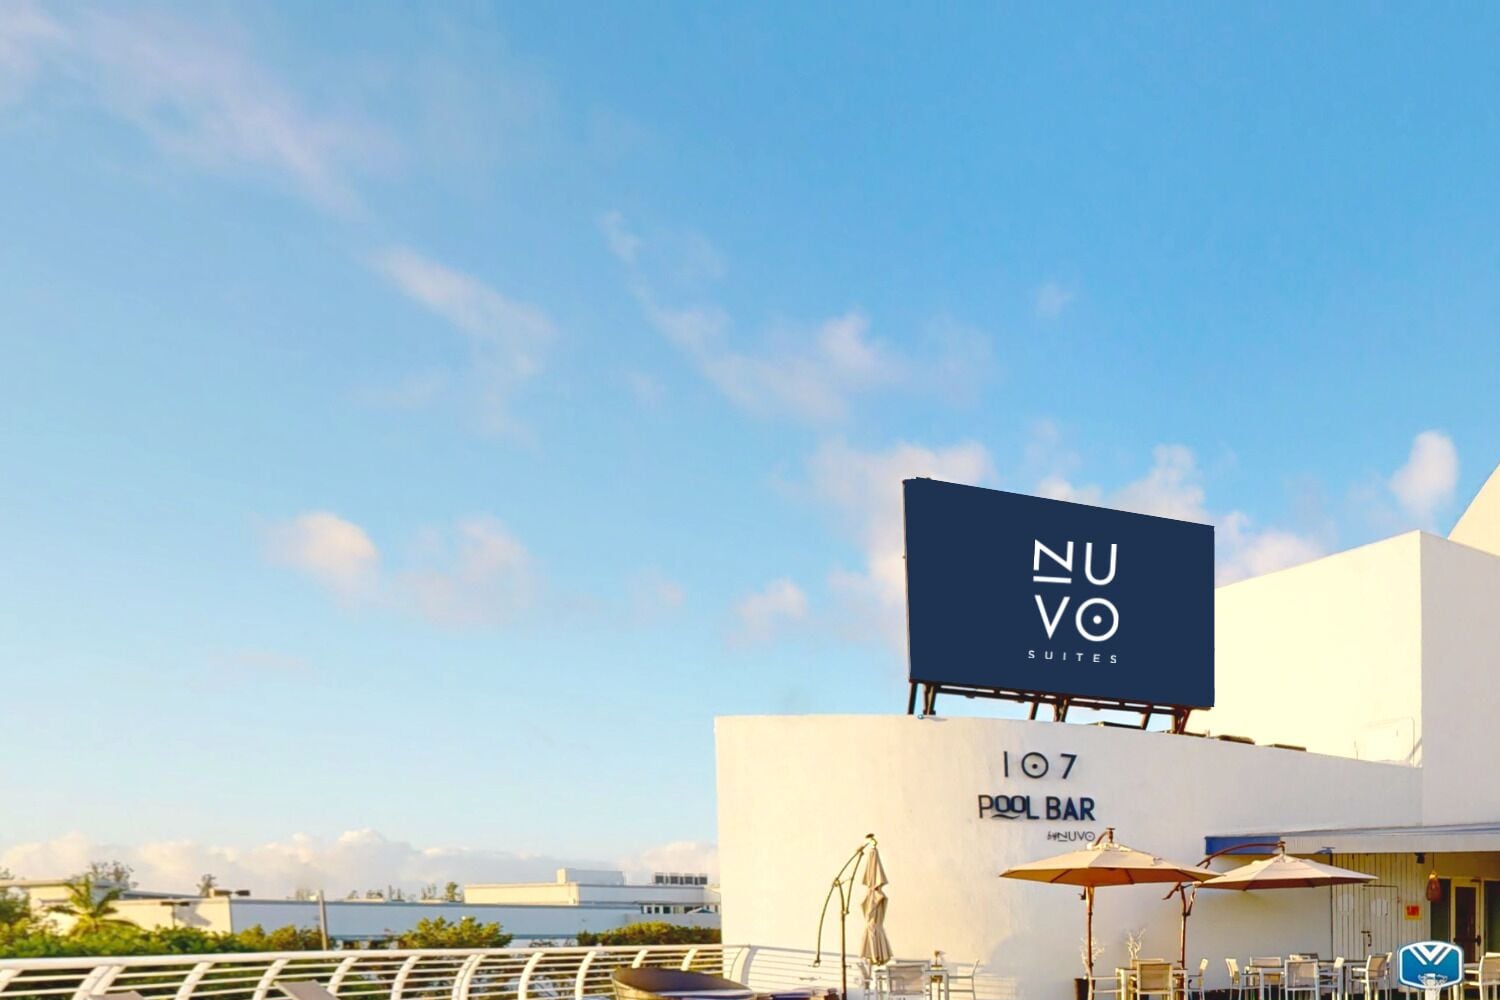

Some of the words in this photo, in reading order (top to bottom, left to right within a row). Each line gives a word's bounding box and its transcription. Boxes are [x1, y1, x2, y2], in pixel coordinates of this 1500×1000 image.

[1033, 539, 1118, 586] NU
[1034, 595, 1119, 642] VO
[1028, 650, 1117, 664] SUITES
[1003, 751, 1077, 779] 107
[978, 794, 1040, 820] POOL
[1046, 796, 1096, 821] BAR
[1057, 831, 1096, 842] NUVO
